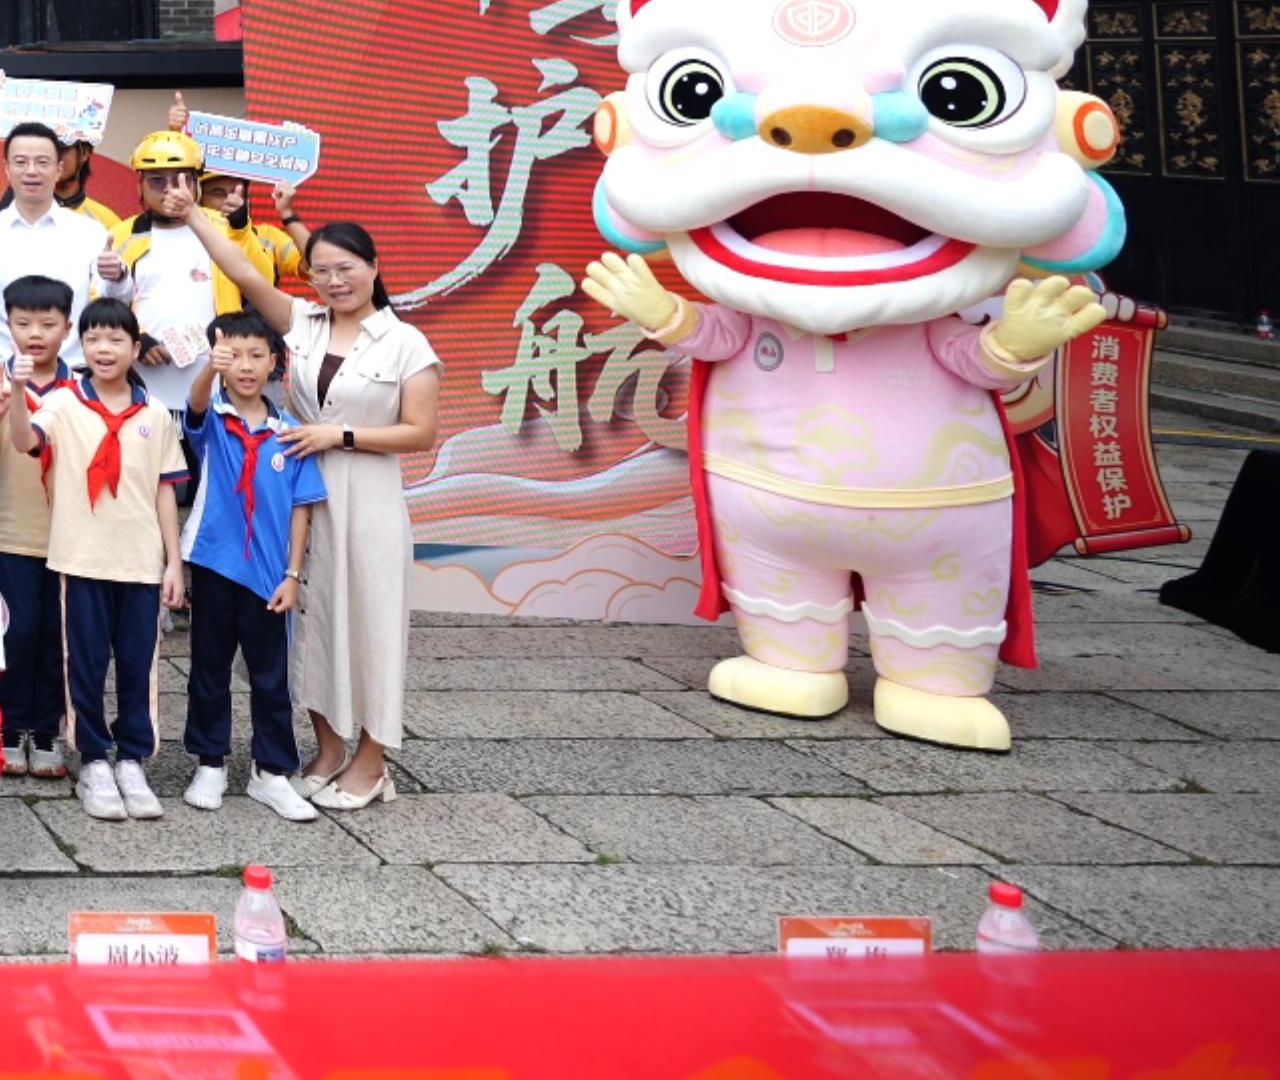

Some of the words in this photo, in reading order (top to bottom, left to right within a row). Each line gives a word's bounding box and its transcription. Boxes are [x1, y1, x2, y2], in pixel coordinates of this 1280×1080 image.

[1088, 334, 1133, 520] 消费者权益保护
